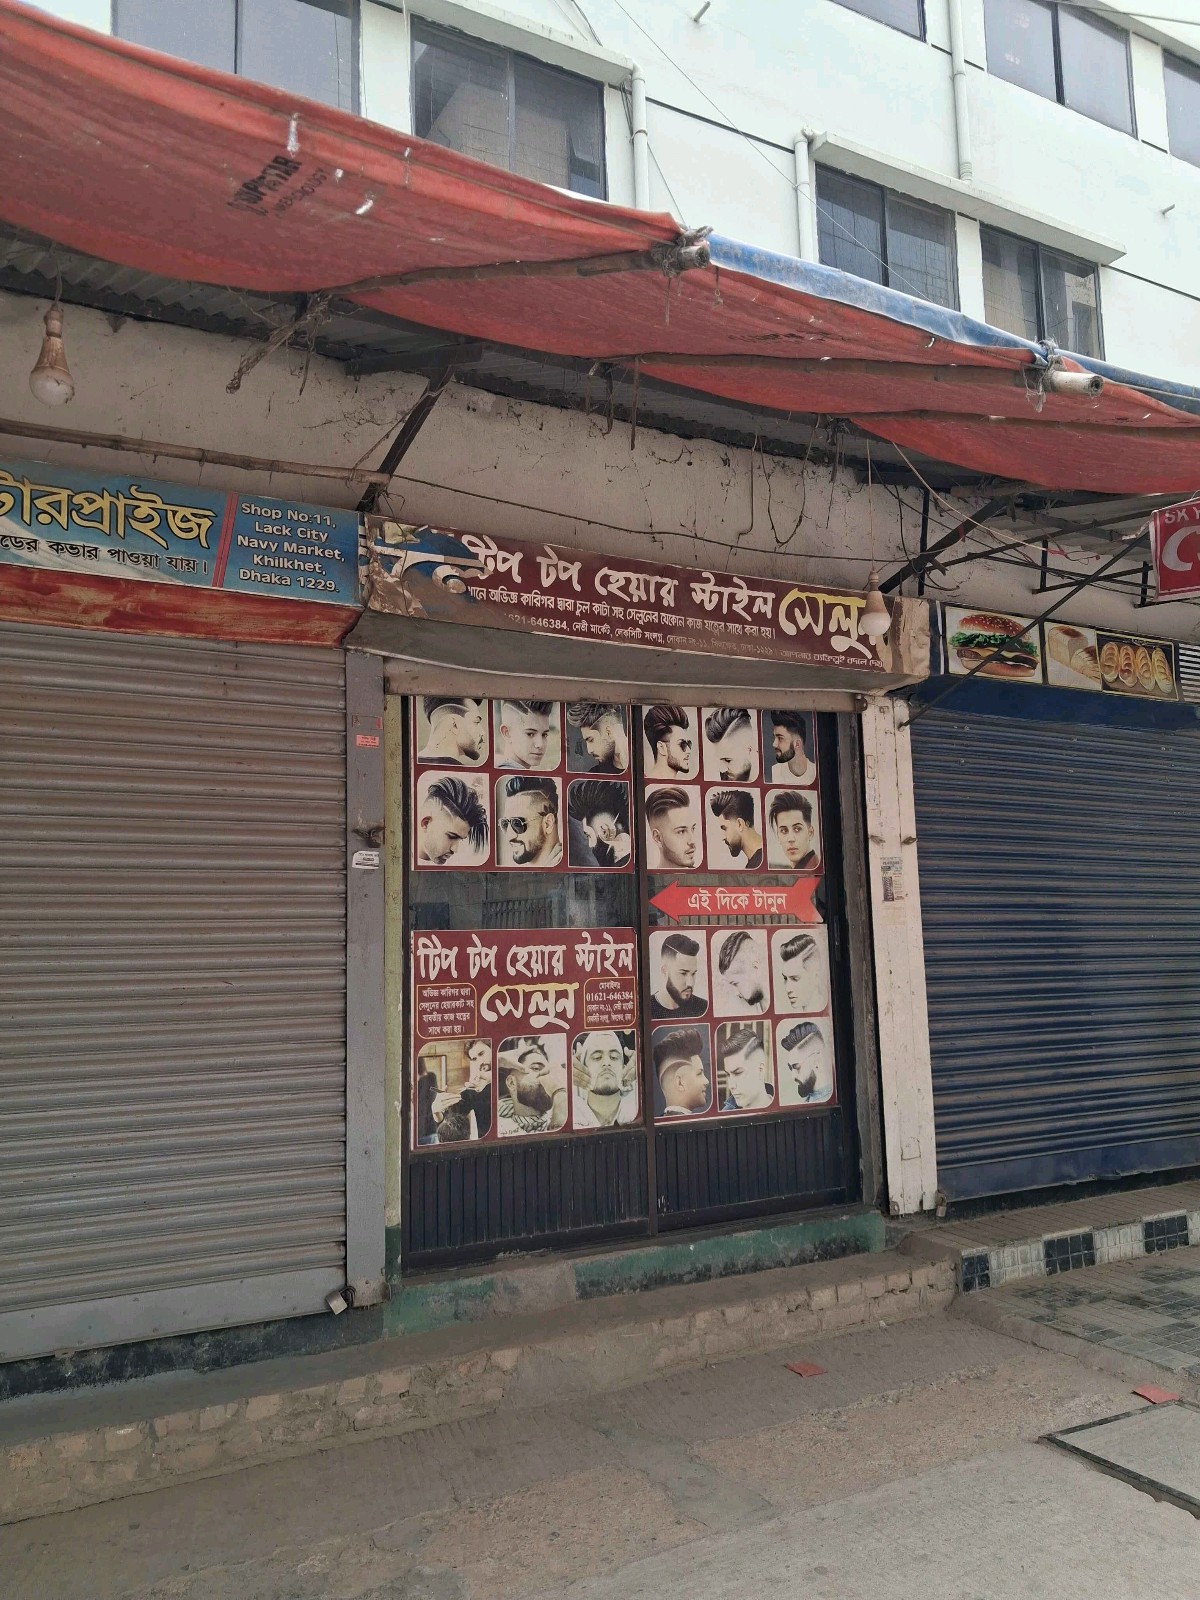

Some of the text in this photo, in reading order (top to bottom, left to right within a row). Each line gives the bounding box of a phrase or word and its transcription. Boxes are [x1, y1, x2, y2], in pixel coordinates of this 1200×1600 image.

[241, 502, 336, 528] Shop No:11,
[255, 521, 328, 543] Lack City
[46, 540, 100, 560] কভার
[107, 547, 161, 569] পাওয়া
[237, 535, 345, 562] Navy Market,
[253, 554, 326, 576] Khilkhet,
[239, 568, 340, 593] Dhaka 1229.
[536, 544, 584, 592] টপ
[594, 565, 679, 608] হেয়ার
[689, 571, 776, 621] স্টাইল
[488, 585, 518, 604] অভিজ্ঞ
[520, 589, 555, 609] কারিগর
[557, 597, 574, 612] দ্বারা
[576, 600, 591, 617] চুল
[592, 601, 610, 617] কাটা
[612, 606, 624, 620] সহ
[626, 608, 659, 625] সেলুনের
[660, 612, 685, 628] যেকোন
[686, 617, 703, 631] কাজ
[726, 622, 743, 635] সাথে
[744, 626, 759, 638] করা
[687, 887, 788, 913] এই দিকে টানুন
[416, 931, 634, 981] টিপ টপ হেয়ার স্টাইল
[480, 981, 580, 1030] সেলুন
[586, 991, 633, 1002] 01621-646384
